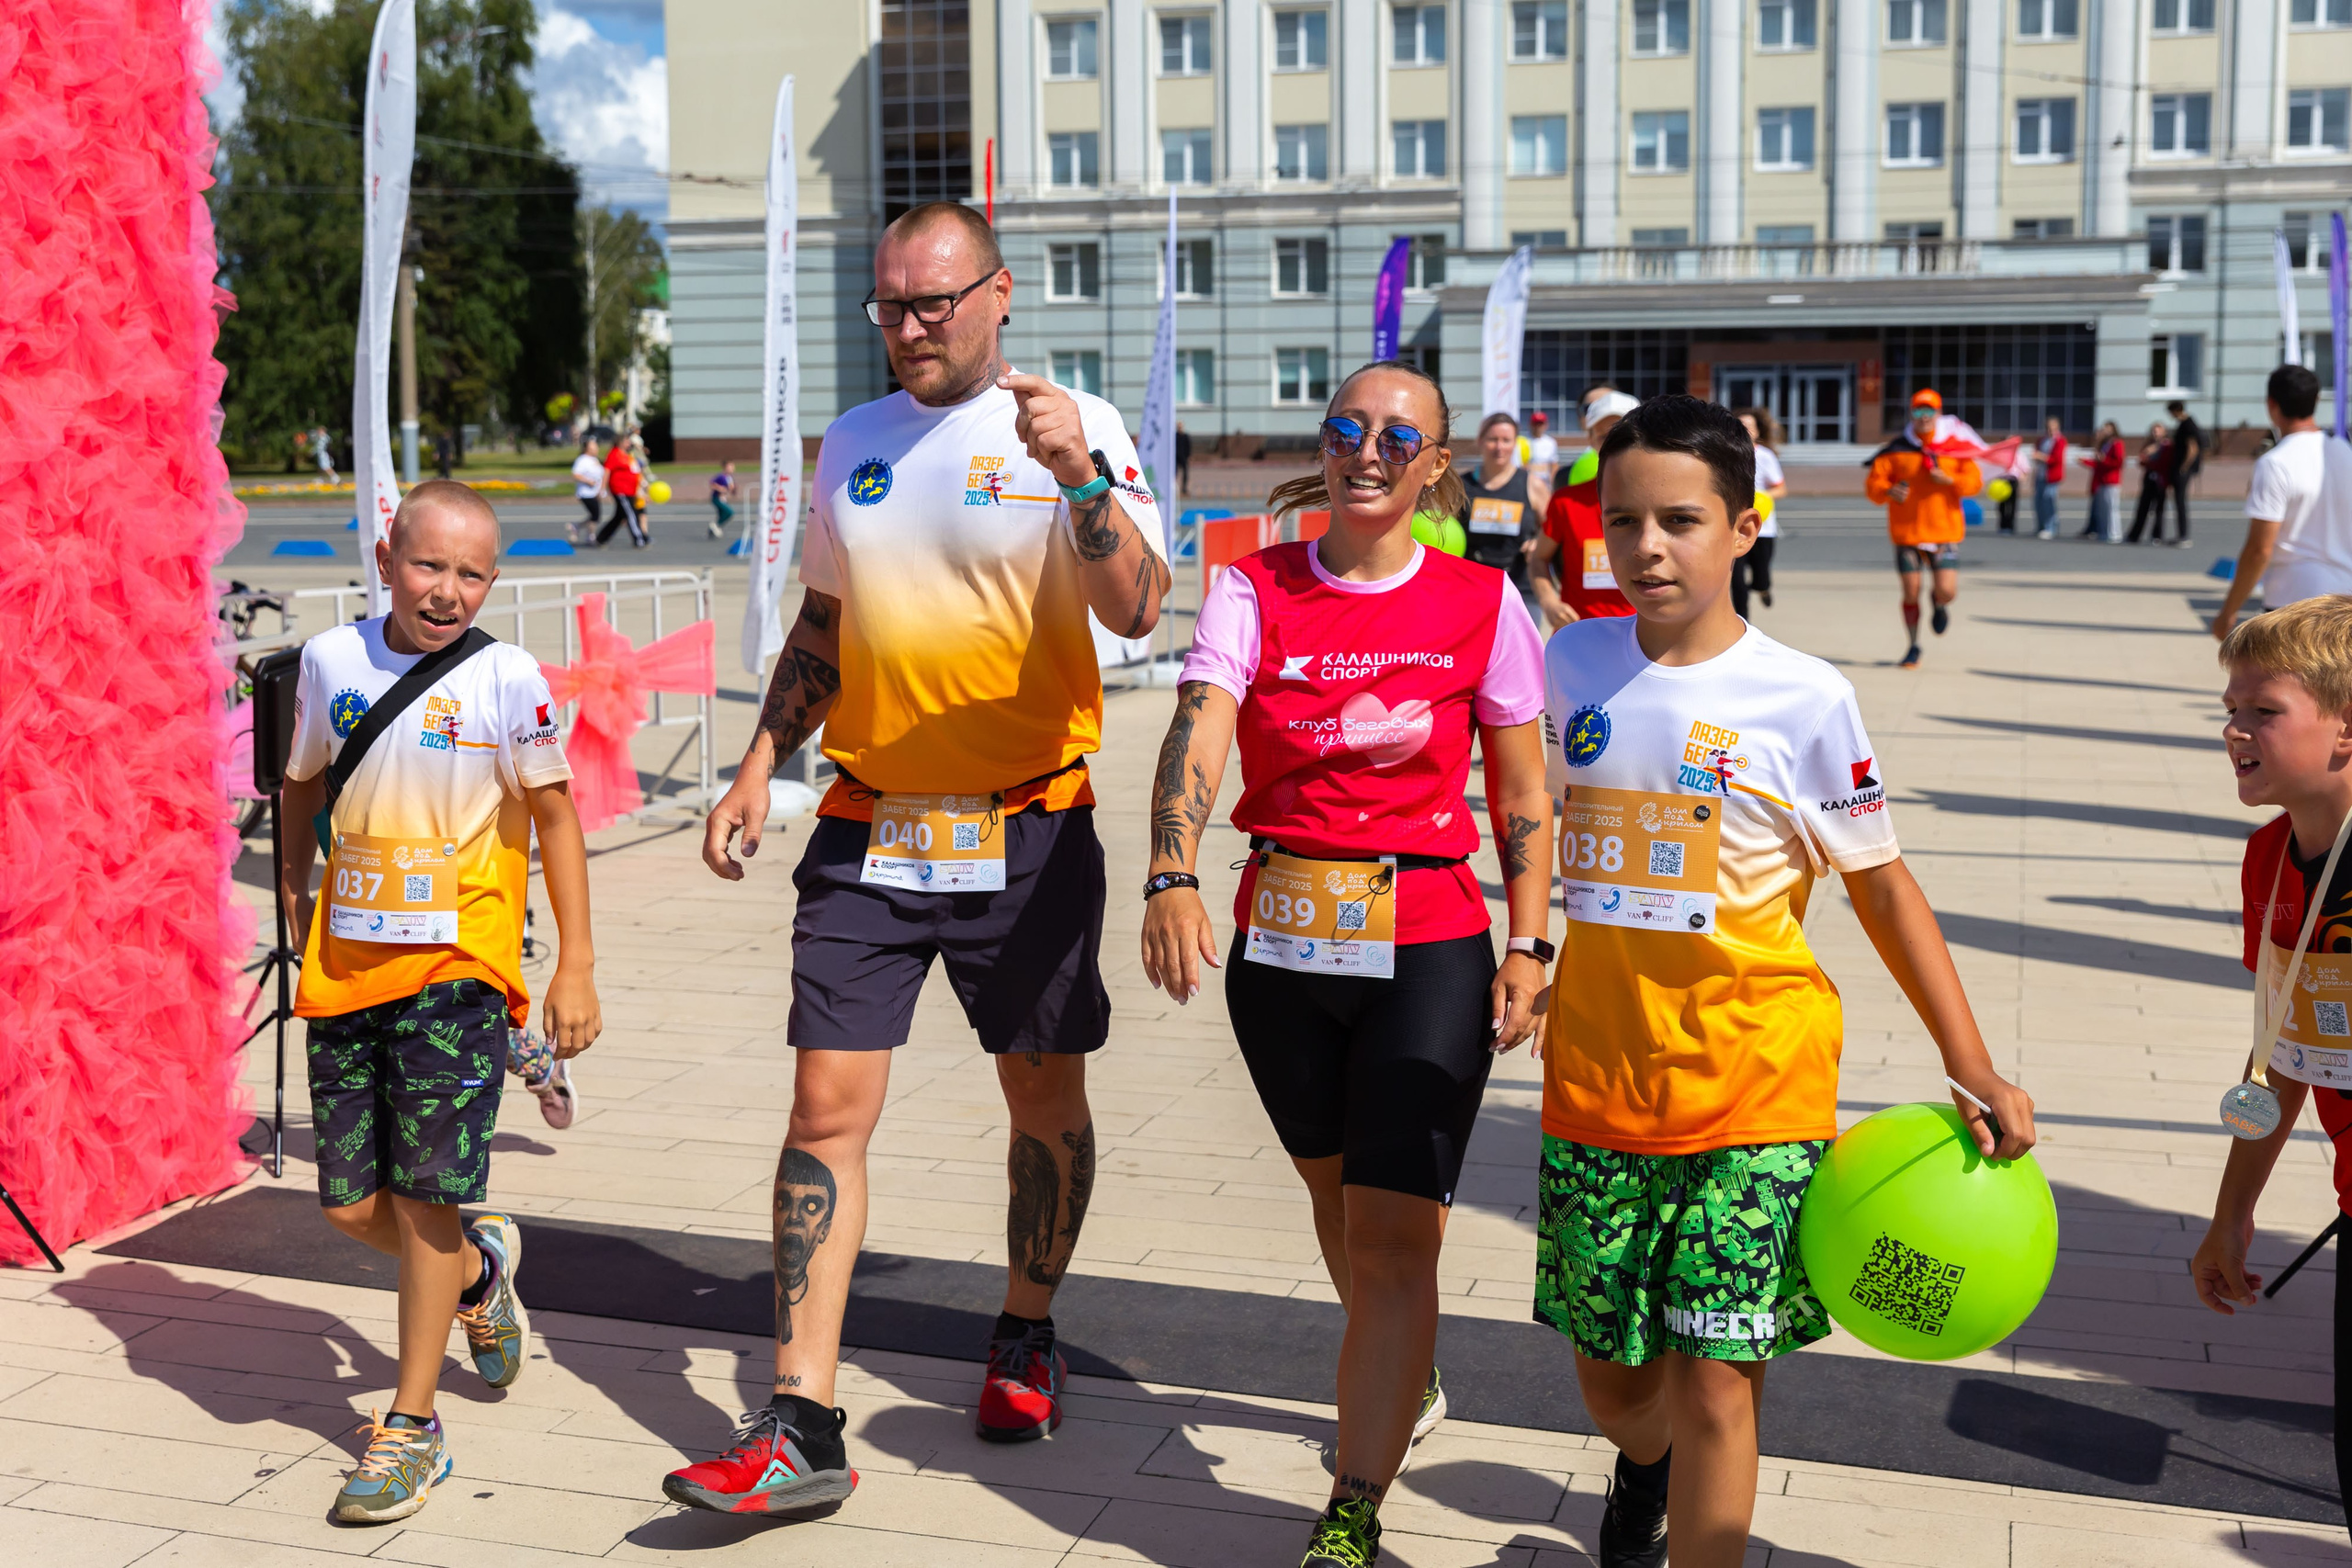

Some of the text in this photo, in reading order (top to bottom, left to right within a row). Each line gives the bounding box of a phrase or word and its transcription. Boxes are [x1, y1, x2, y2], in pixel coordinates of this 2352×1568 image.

[969, 456, 1005, 470] ЛАЗЕР
[964, 490, 990, 505] 2025
[767, 472, 790, 563] СПОРТ
[1322, 652, 1453, 669] КАЛАШНИКОВ
[1320, 665, 1381, 681] СПОРТ
[425, 695, 462, 716] ЛАЗЕР
[1289, 716, 1430, 733] клуб беговых
[419, 731, 448, 750] 2025
[1314, 730, 1406, 756] принцесс
[1689, 720, 1739, 750] ЛАЗЕР
[1677, 764, 1716, 793] 2025
[882, 805, 930, 817] ЗАБЕГ 2025
[1664, 807, 1688, 815] Дом
[1849, 798, 1886, 818] СПОР
[1566, 811, 1623, 828] ЗАБЕГ 2025
[879, 819, 933, 852] 040
[340, 852, 381, 866] ЗАБЕГ 2025
[1564, 830, 1624, 872] 038
[336, 867, 384, 901] 037
[1262, 873, 1312, 891] ЗАБЕГ 2025
[1259, 889, 1316, 928] 039
[2223, 1111, 2265, 1137] ЗАБЕГ
